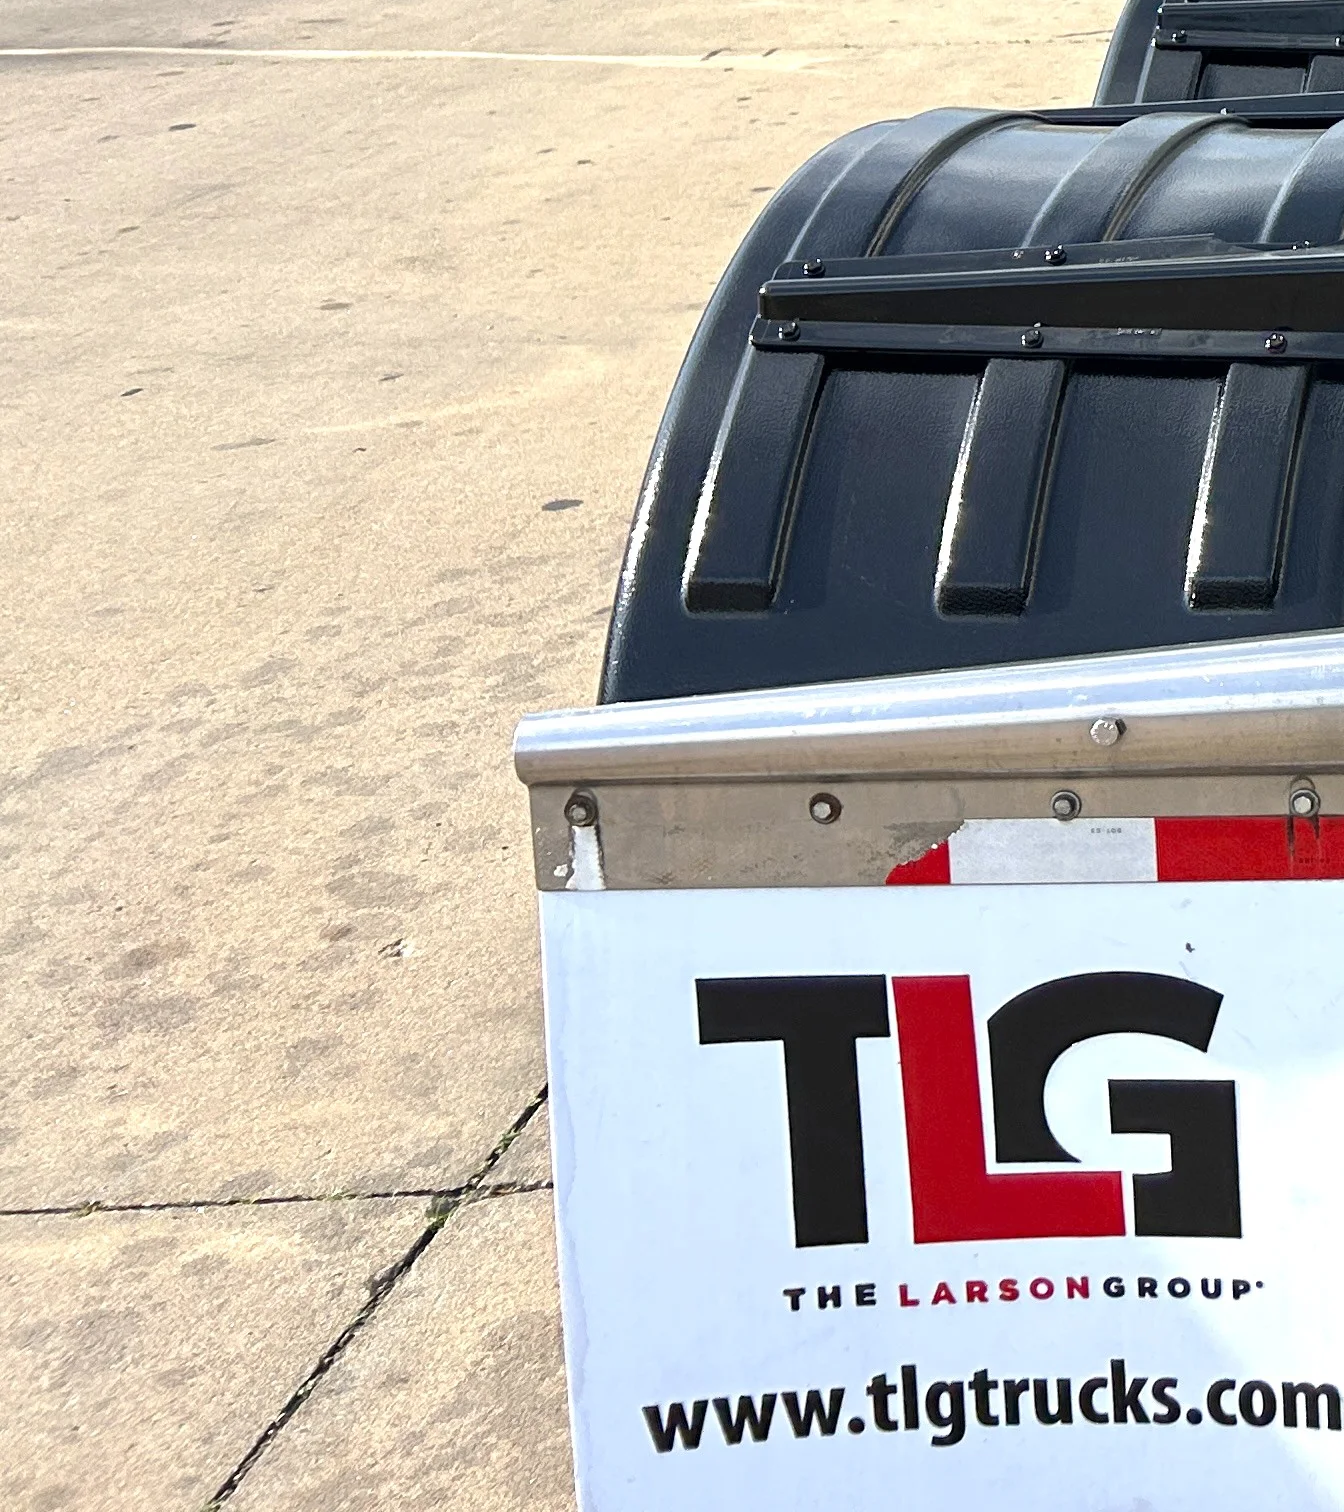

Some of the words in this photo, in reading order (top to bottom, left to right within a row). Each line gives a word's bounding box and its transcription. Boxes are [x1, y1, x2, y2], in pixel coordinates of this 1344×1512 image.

[694, 970, 1243, 1246] TLG
[783, 1285, 878, 1311] THE
[641, 1359, 1344, 1454] www.tlgtrucks.com
